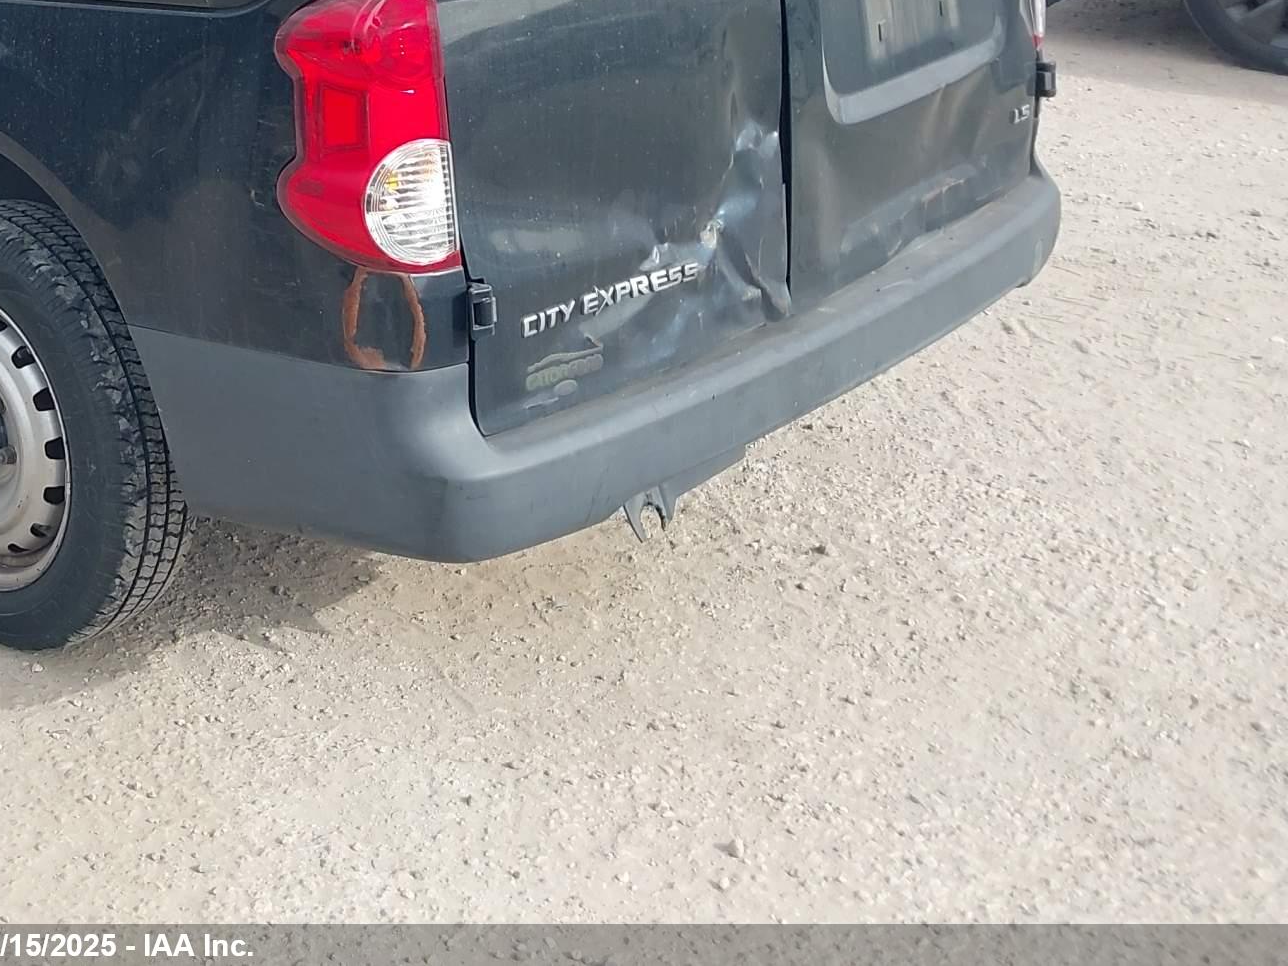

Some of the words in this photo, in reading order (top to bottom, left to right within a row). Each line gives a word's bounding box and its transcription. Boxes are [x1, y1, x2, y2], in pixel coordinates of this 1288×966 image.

[1011, 103, 1031, 125] LS
[521, 299, 576, 338] CITY
[580, 262, 699, 316] EXPRESS
